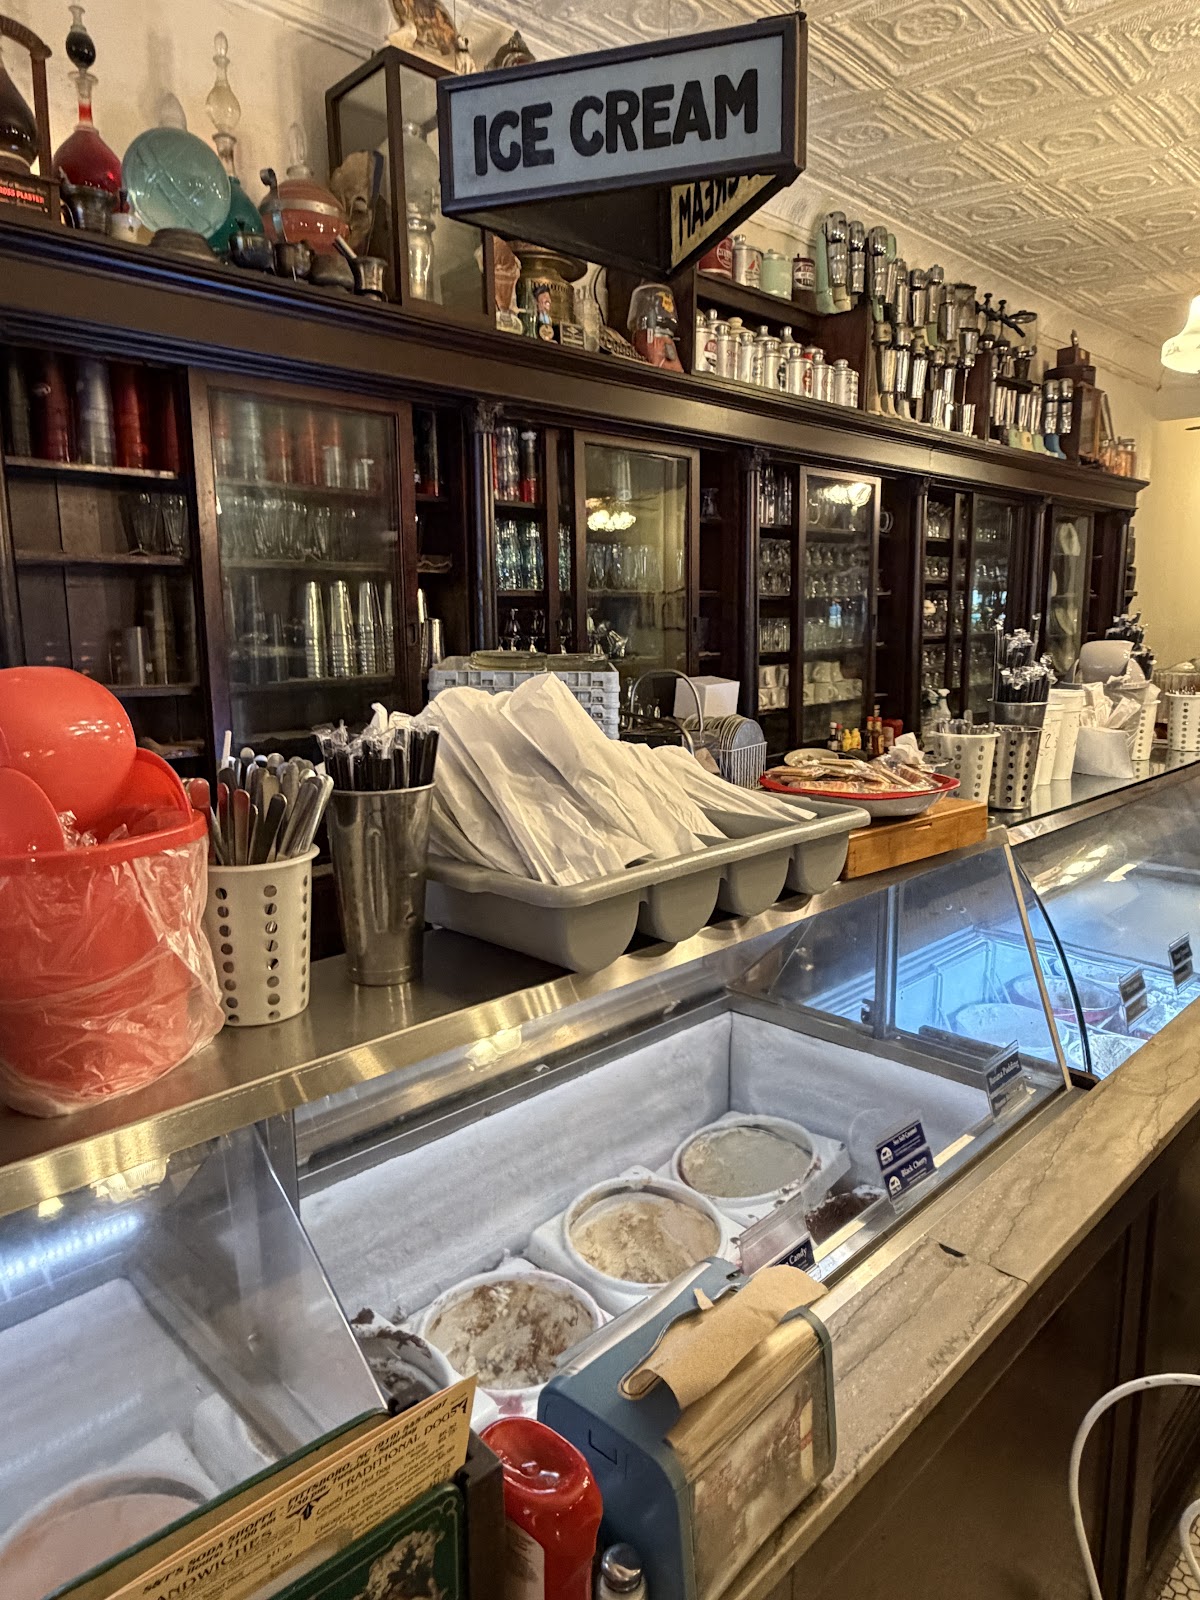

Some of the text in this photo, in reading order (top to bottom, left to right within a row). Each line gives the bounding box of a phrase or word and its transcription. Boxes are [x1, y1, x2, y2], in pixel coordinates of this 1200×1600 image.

[473, 68, 758, 176] ICE CREAM
[788, 1247, 807, 1265] Candy
[338, 1434, 420, 1491] TRADITIONAL
[424, 1406, 457, 1436] DOGS
[188, 1541, 224, 1566] SODA
[227, 1508, 278, 1543] SHOPPE
